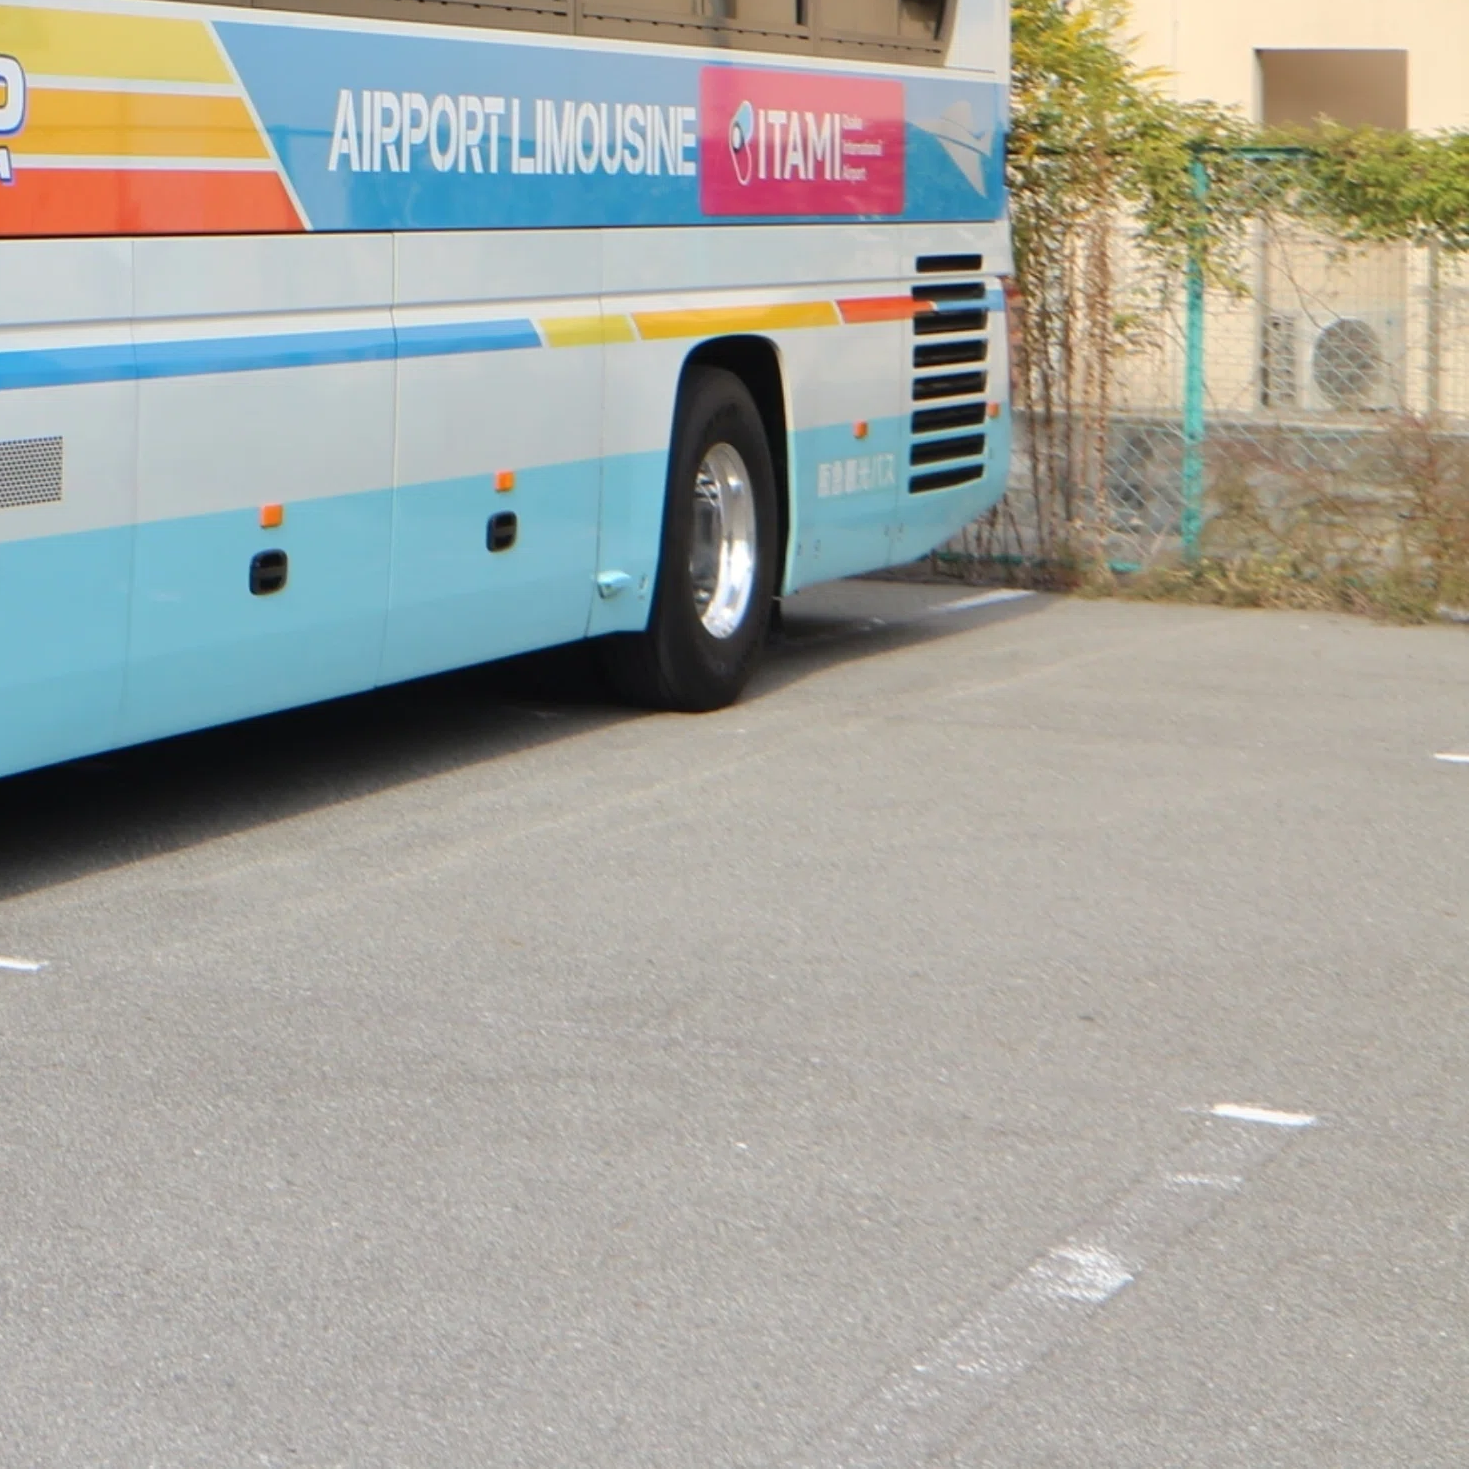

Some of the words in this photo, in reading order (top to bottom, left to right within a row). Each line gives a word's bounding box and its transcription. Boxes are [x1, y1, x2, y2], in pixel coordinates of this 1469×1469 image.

[328, 89, 505, 174] AIRPORT
[511, 98, 696, 176] LIMOUSINE
[758, 108, 841, 181] ITAMI
